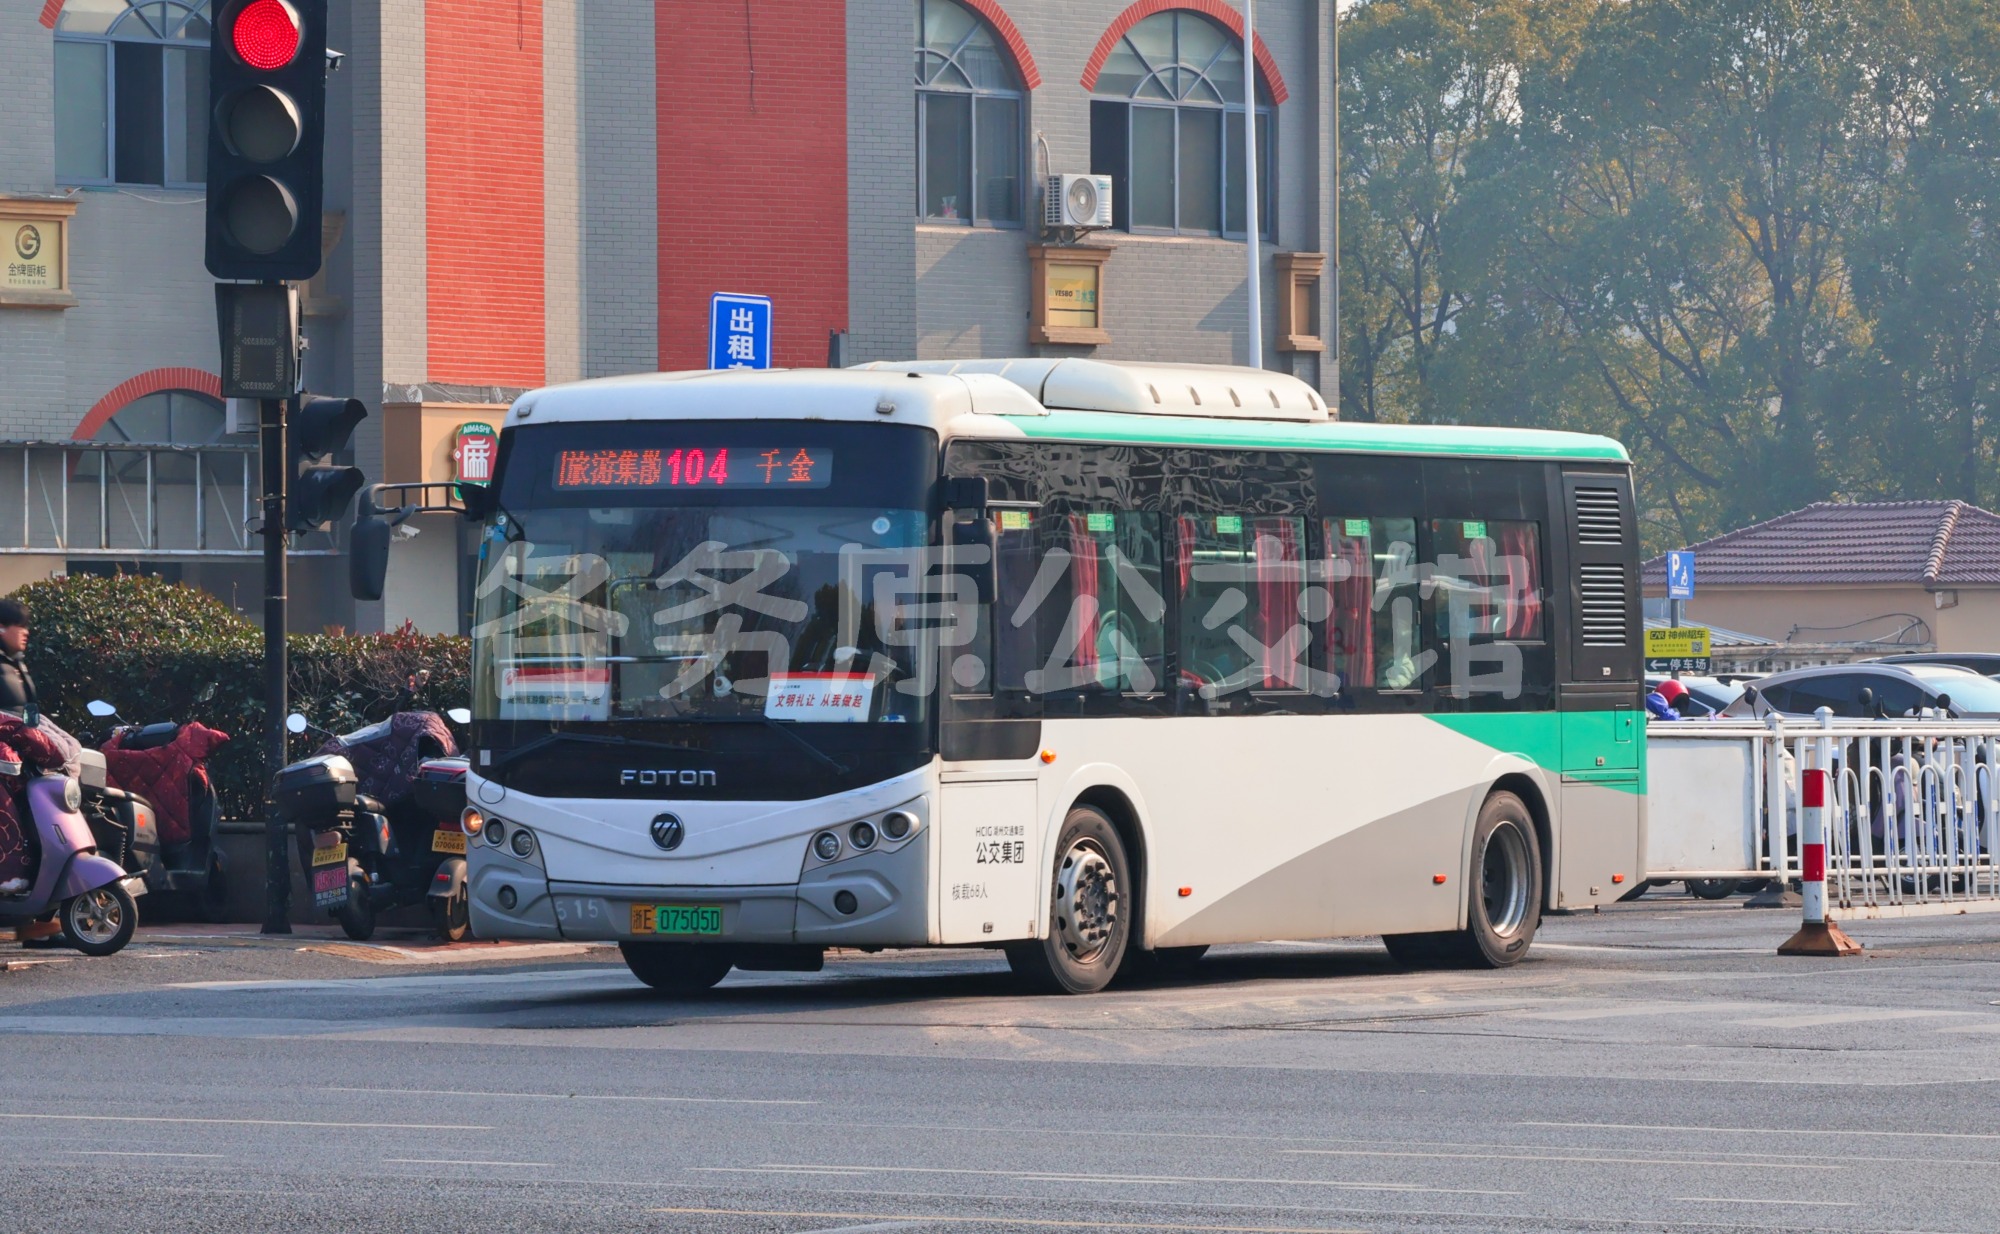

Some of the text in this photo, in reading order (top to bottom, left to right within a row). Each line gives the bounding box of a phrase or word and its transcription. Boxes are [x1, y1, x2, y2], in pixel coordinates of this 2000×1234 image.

[8, 262, 47, 277] 金牌厨柜
[1054, 289, 1073, 297] VESBO
[727, 307, 755, 369] 出租
[463, 437, 490, 478] 麻
[558, 449, 815, 486] 旅游集散 104 千金
[1671, 553, 1680, 578] P
[1669, 658, 1707, 671] 停车场
[775, 693, 863, 708] 文明礼让 从我做起
[620, 769, 717, 786] FOTON
[975, 826, 993, 837] HCIG
[976, 840, 1025, 864] 公交集团
[952, 882, 988, 901] 核载68人
